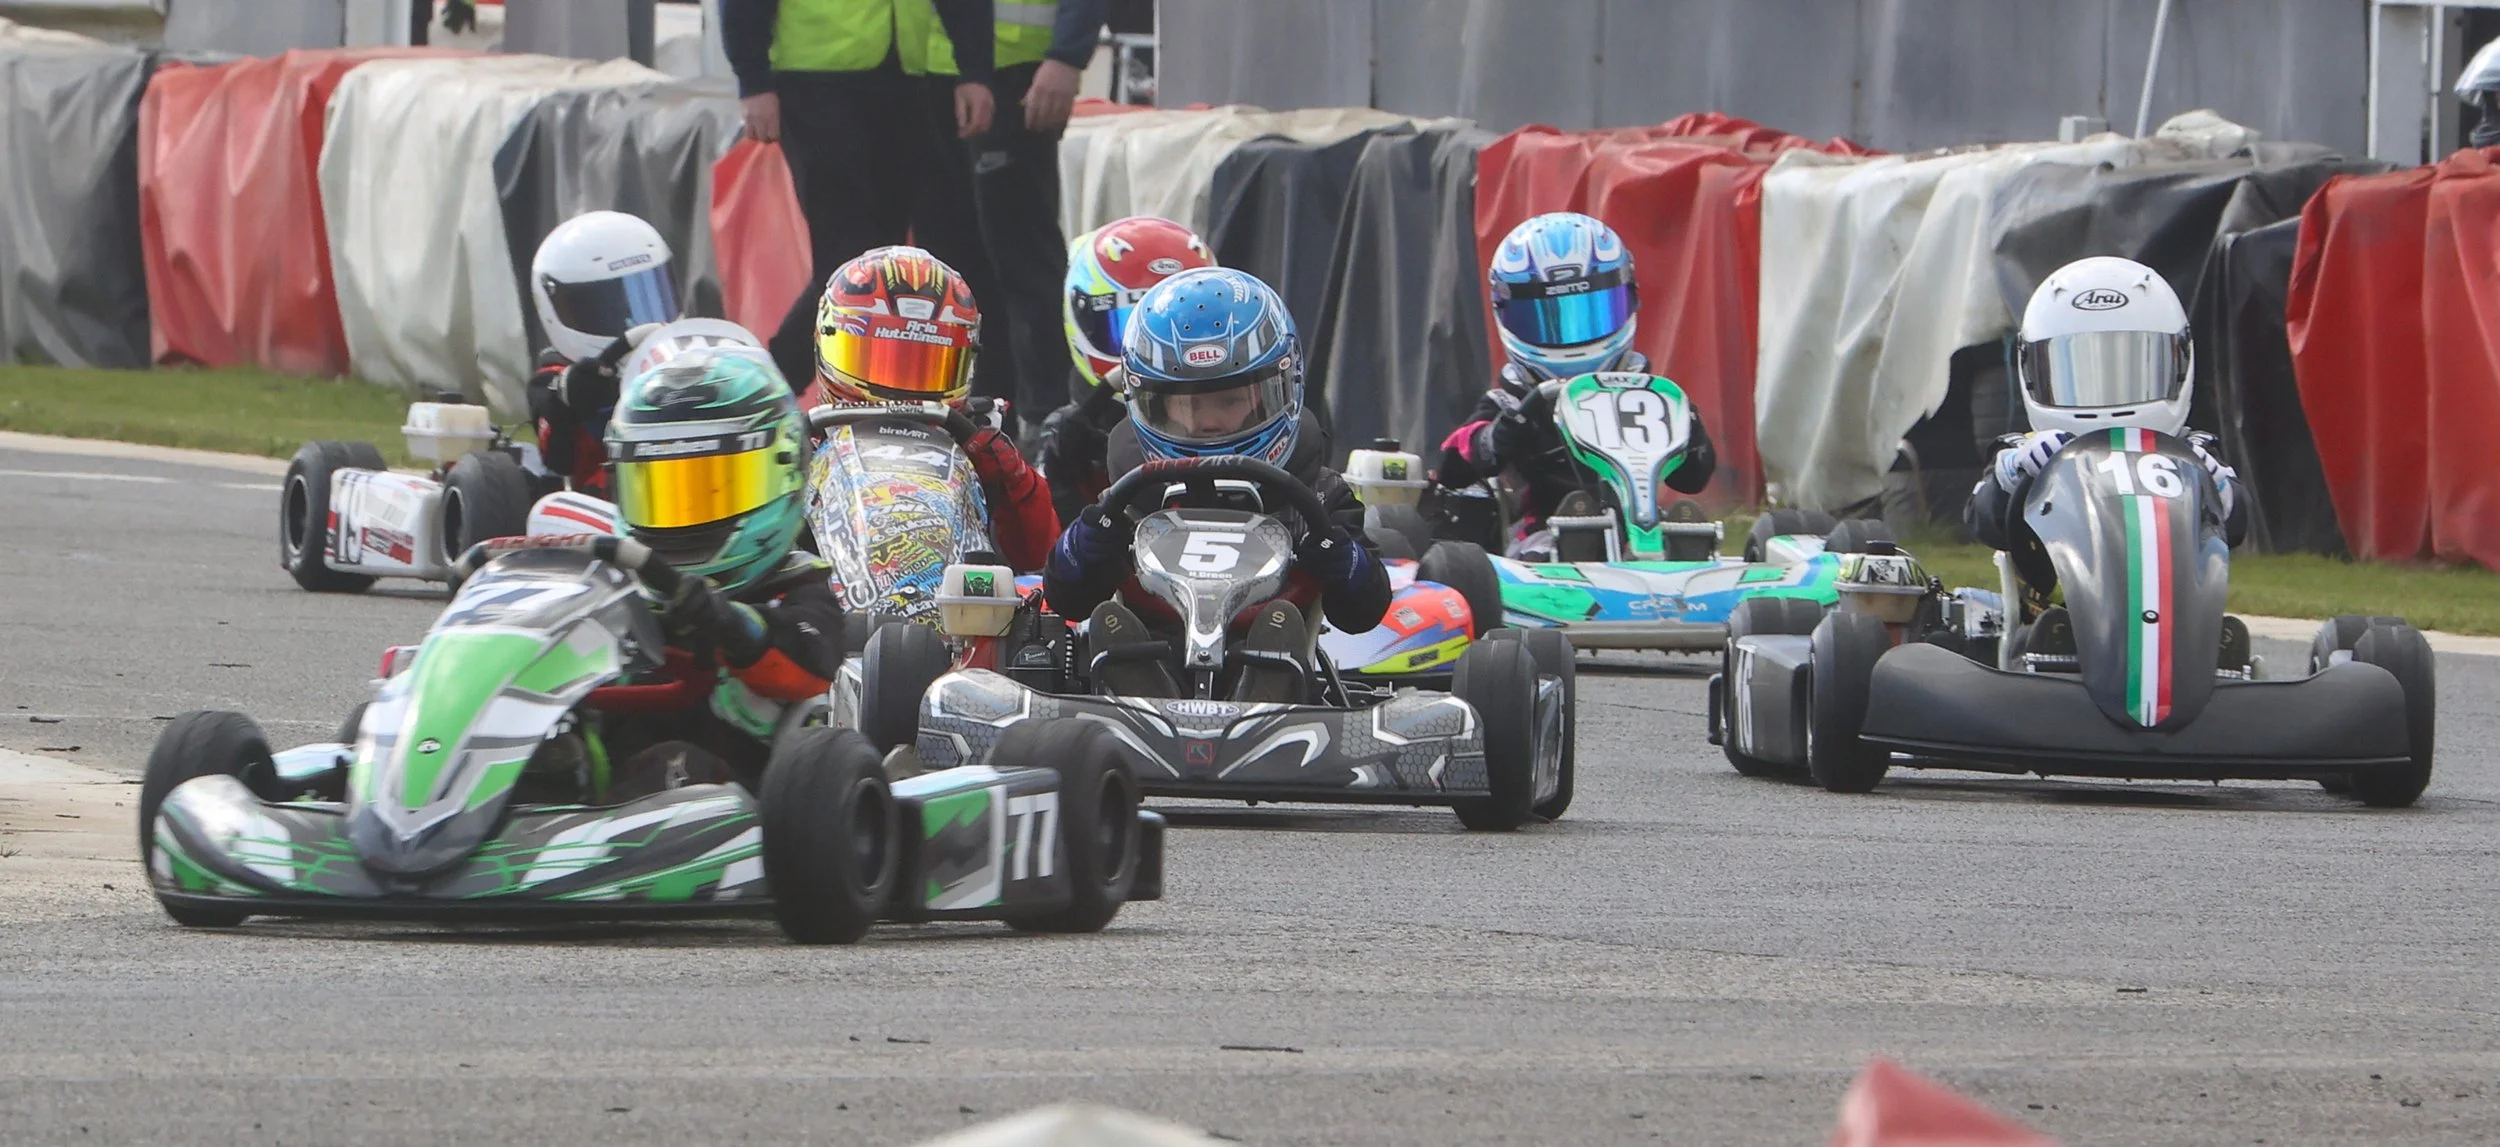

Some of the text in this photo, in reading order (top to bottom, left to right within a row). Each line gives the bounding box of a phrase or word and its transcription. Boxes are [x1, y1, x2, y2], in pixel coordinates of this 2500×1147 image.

[2076, 291, 2121, 305] Arai
[875, 327, 953, 346] Hutchinson
[1189, 350, 1221, 361] BELL
[1578, 389, 1673, 452] 13
[878, 426, 931, 440] birelART
[860, 444, 949, 467] 44
[1268, 442, 1286, 461] BELL
[2097, 451, 2184, 498] 16
[1178, 531, 1246, 572] 5
[440, 580, 592, 627] 77
[1006, 791, 1060, 881] 77
